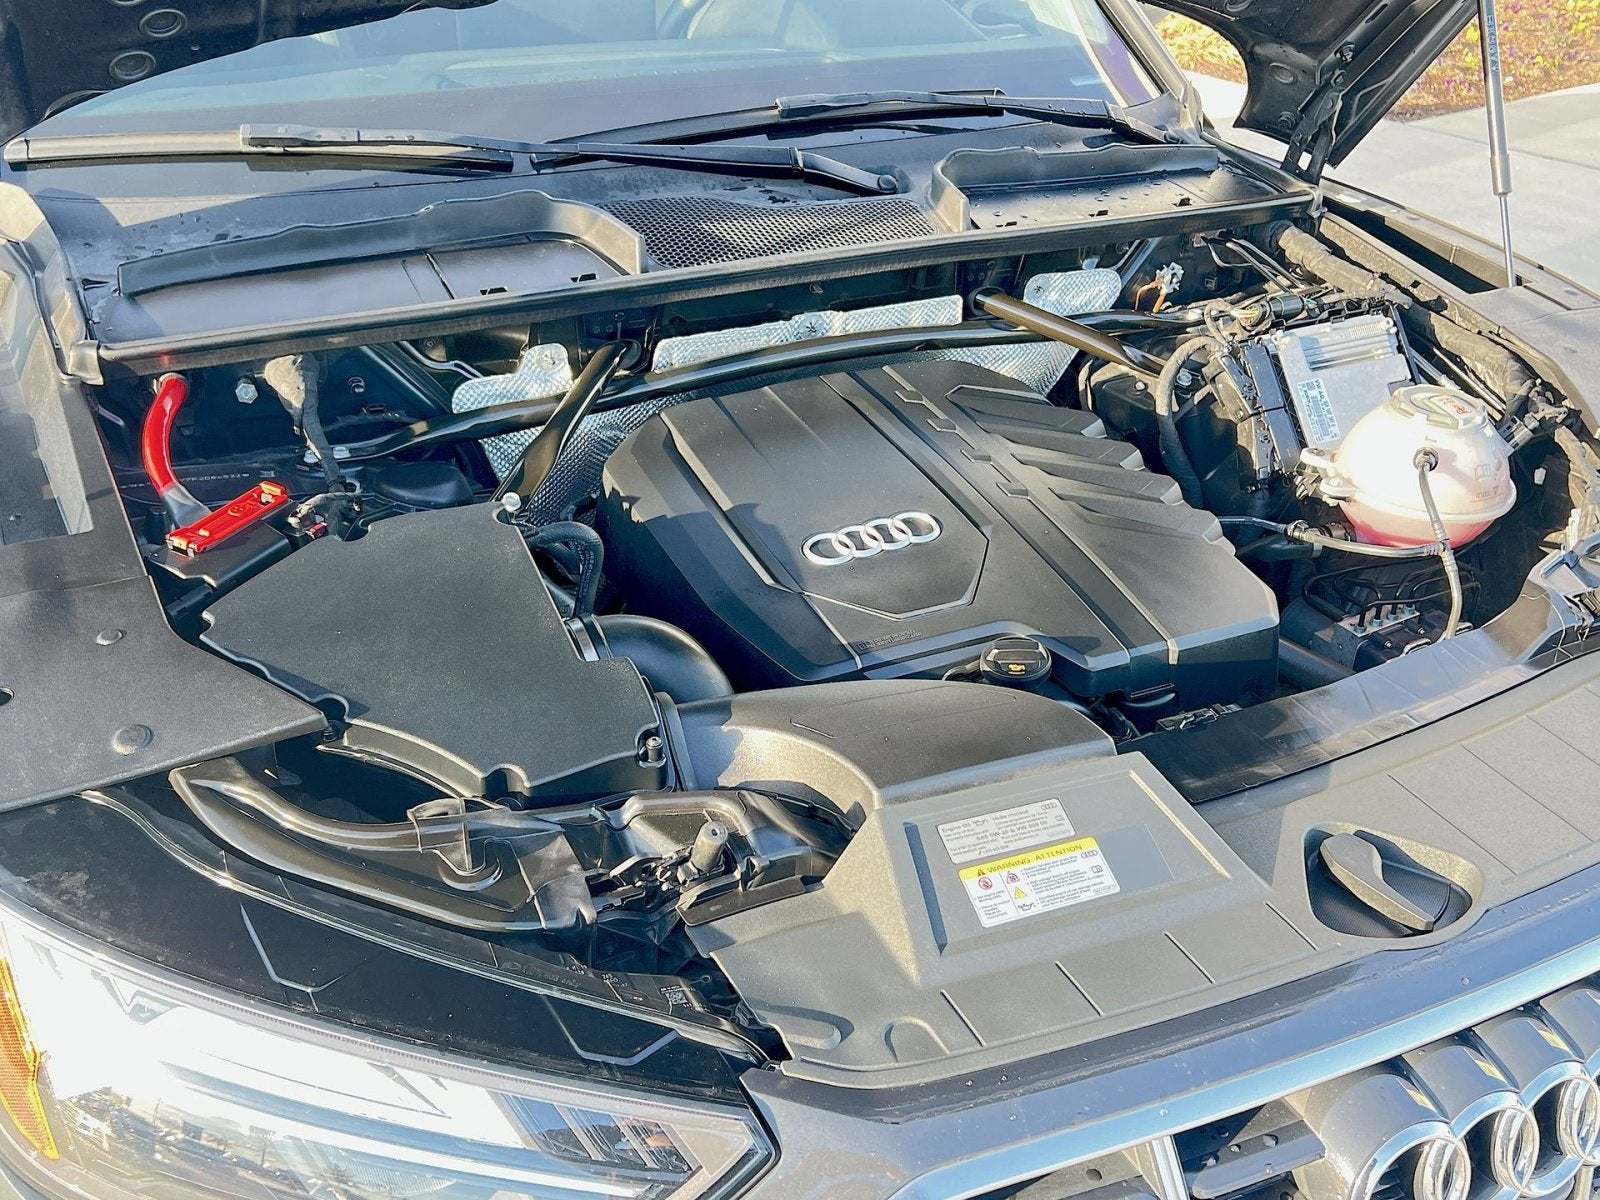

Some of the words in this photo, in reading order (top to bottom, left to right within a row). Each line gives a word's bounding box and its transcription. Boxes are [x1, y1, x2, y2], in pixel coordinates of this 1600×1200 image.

[1315, 379, 1322, 389] VW
[942, 825, 961, 833] Engine
[987, 858, 1031, 873] WARNING
[1034, 844, 1083, 861] ATTENTION
